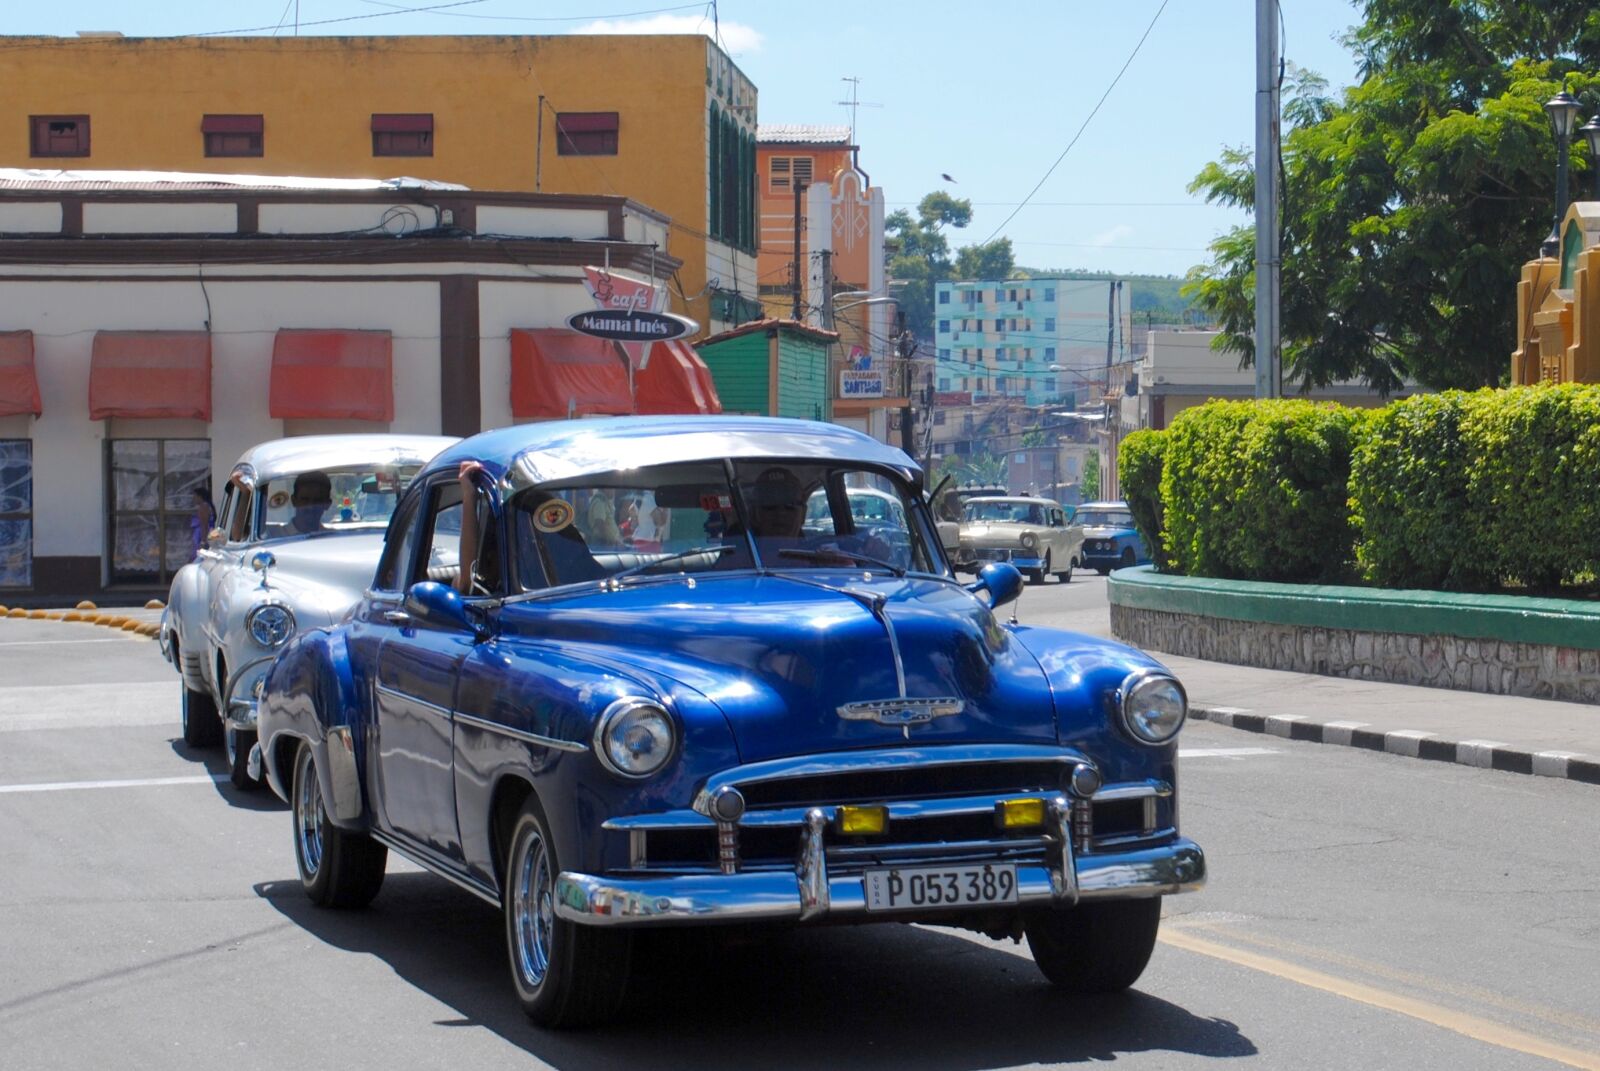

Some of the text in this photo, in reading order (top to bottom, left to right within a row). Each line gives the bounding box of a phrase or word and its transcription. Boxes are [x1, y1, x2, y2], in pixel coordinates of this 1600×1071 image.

[582, 316, 668, 334] Mama Inés
[844, 380, 882, 393] SANTIAGO
[887, 870, 1013, 906] P 053 389
